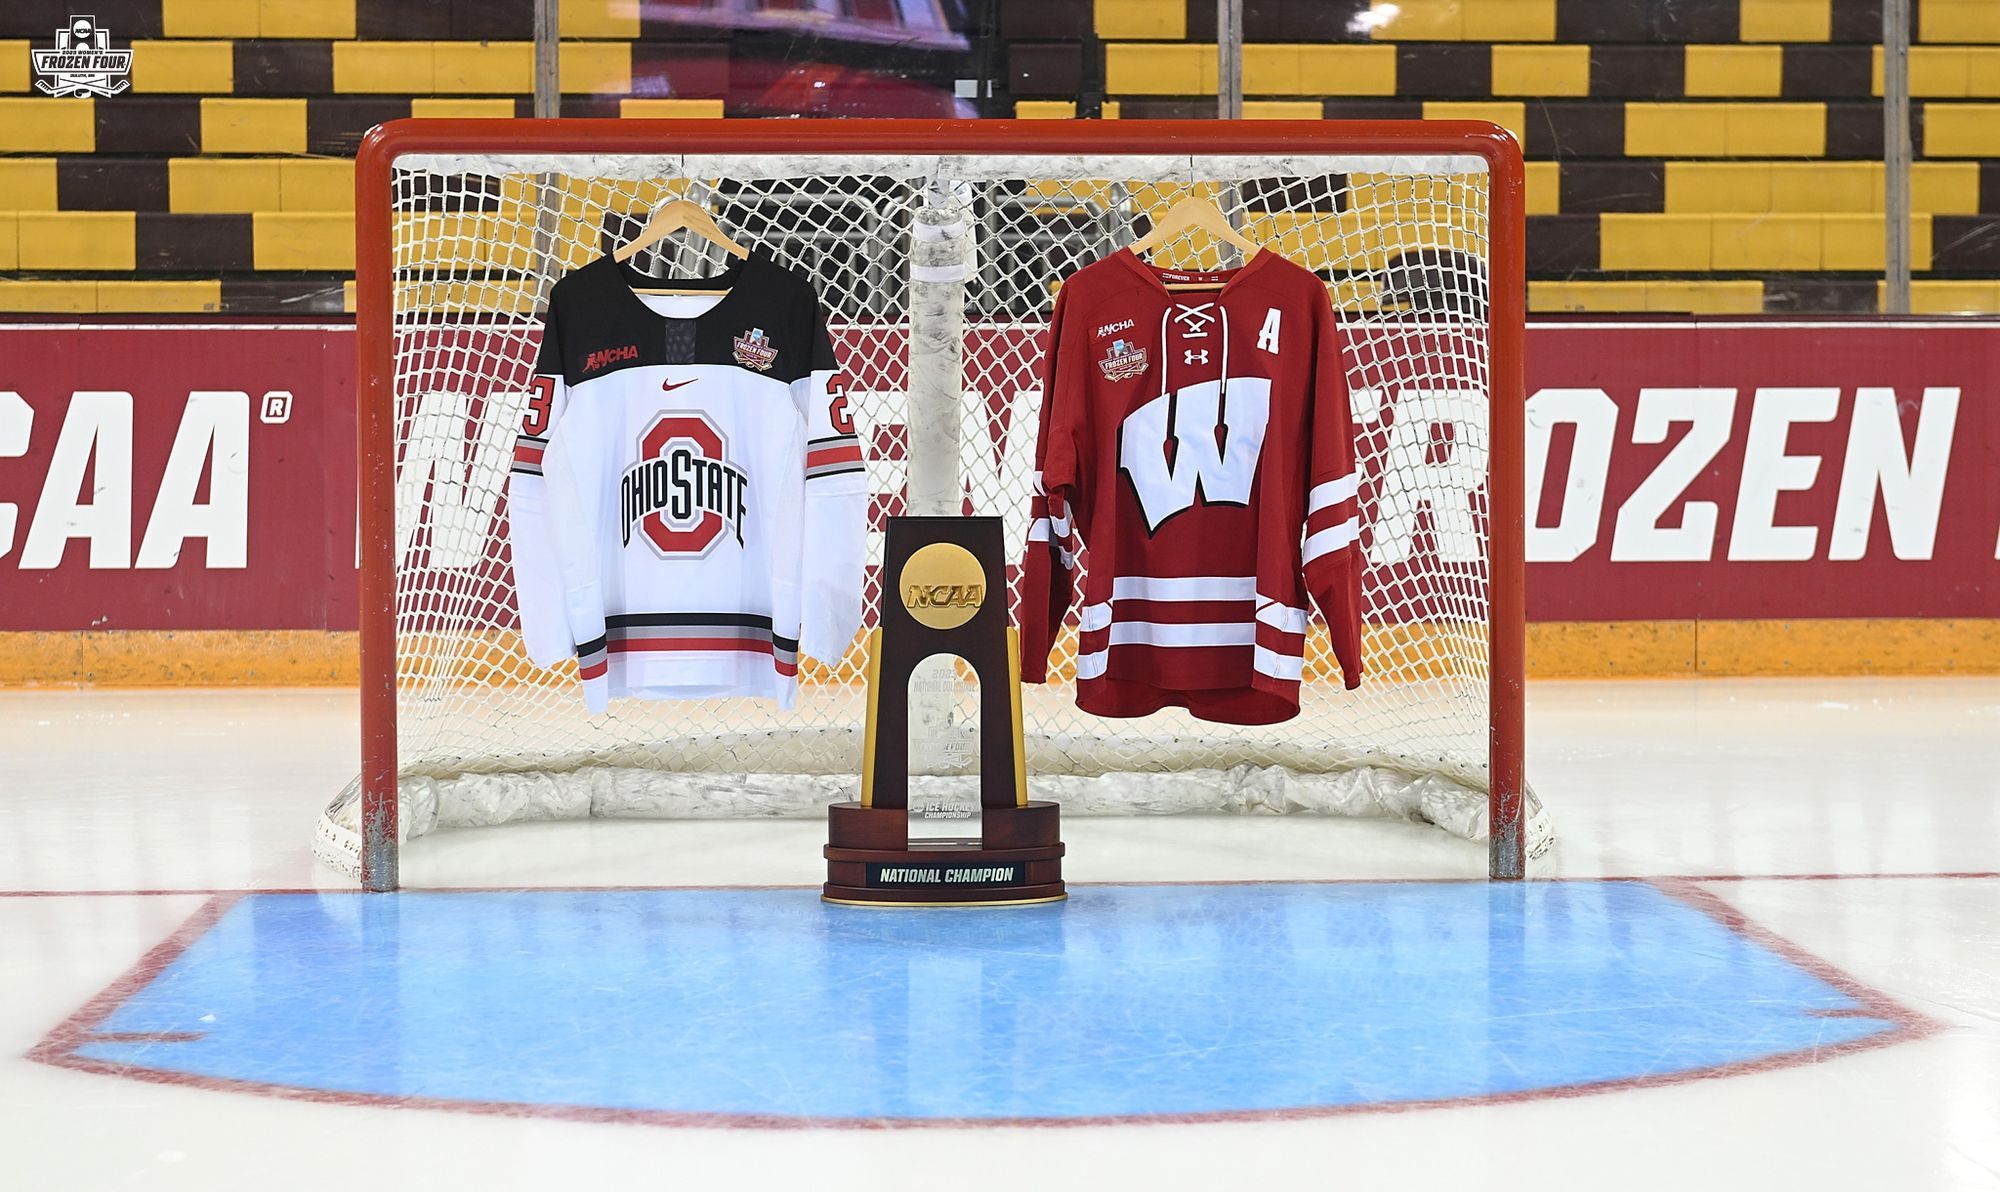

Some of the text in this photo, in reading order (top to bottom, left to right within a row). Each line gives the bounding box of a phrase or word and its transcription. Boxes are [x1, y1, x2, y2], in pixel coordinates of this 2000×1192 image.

[1256, 307, 1281, 354] A
[1116, 377, 1272, 538] W
[1351, 386, 1961, 563] ROZEN
[621, 459, 668, 549] OHIO
[672, 449, 748, 549] STATE
[907, 584, 983, 609] NCAA
[924, 811, 972, 819] CHAMPIONSHIP
[926, 802, 940, 811] ICE
[880, 867, 1014, 883] NATIONAL CHAMPION
